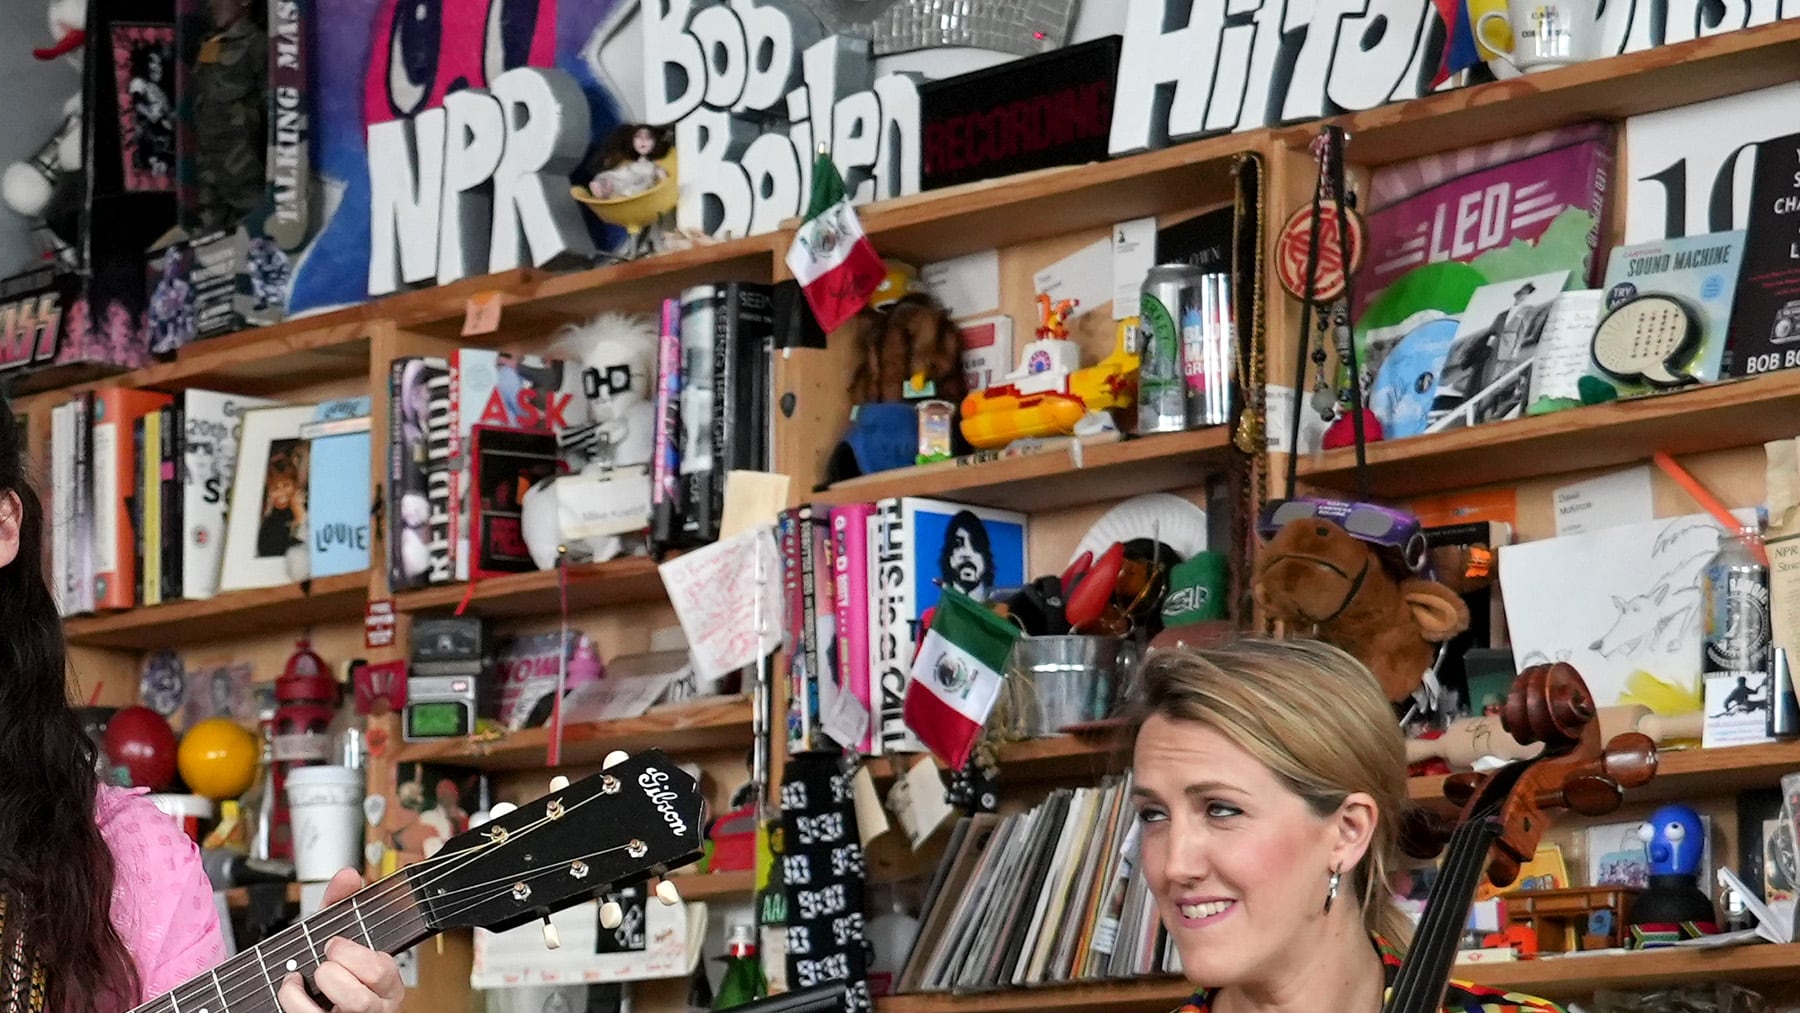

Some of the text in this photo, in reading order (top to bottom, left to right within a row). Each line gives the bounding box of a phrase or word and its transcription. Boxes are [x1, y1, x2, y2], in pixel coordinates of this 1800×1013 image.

[677, 35, 922, 238] Boilen
[925, 80, 1109, 175] RECORDING
[368, 68, 568, 296] NPR
[1428, 181, 1511, 266] LED
[1627, 243, 1732, 278] SOUND MACHINE
[1746, 352, 1780, 375] BOB
[478, 384, 574, 432] ASK
[638, 767, 687, 838] Gibson
